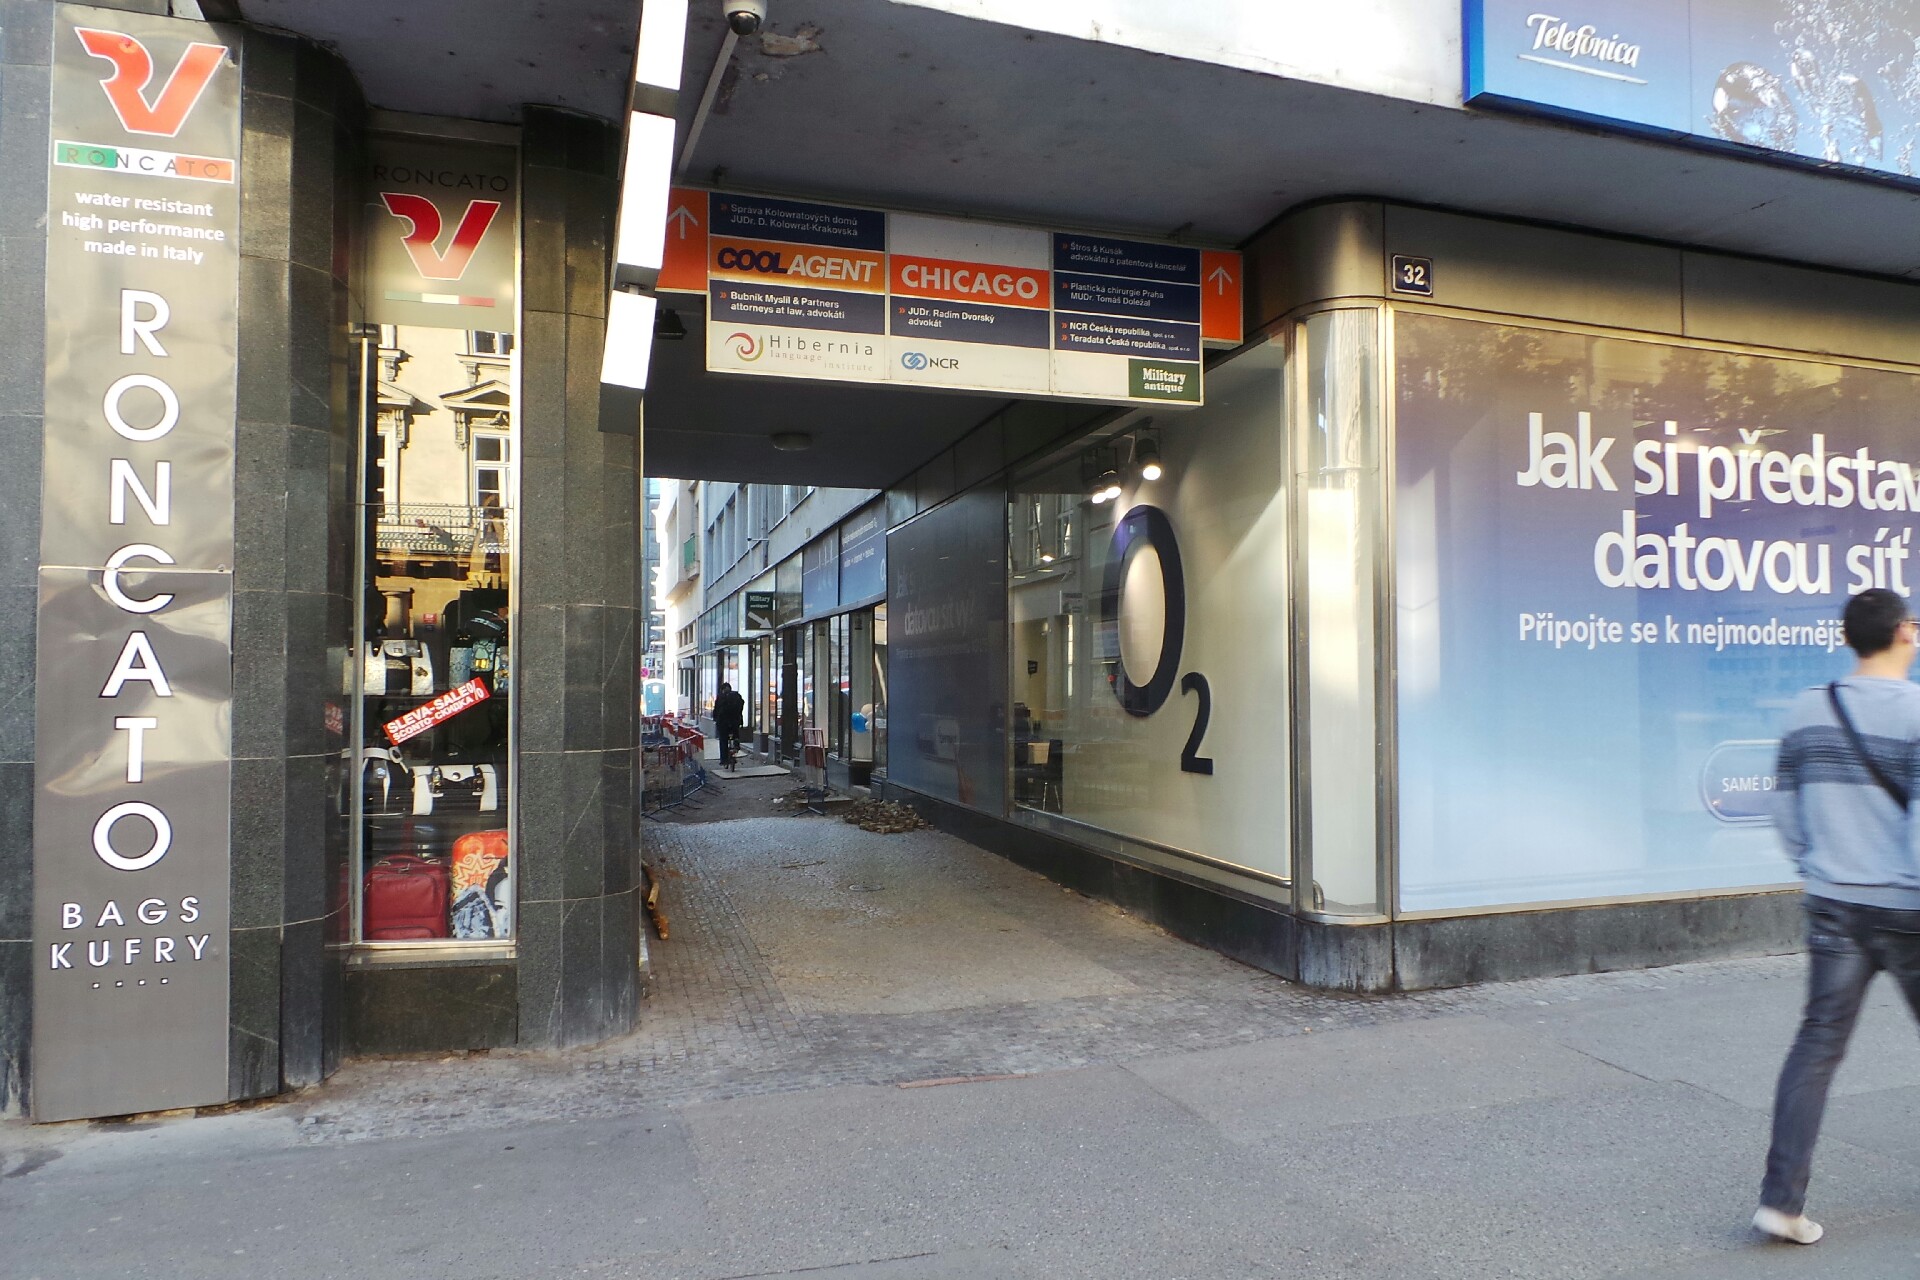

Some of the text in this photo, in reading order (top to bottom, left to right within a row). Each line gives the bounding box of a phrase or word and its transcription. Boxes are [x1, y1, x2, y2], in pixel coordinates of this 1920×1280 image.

[66, 147, 220, 178] RONCATO
[373, 165, 509, 192] RONCATO
[75, 191, 213, 217] water resistant
[62, 211, 225, 241] high performance
[730, 215, 756, 225] JUDr.
[758, 217, 768, 226] D.
[84, 238, 204, 265] made in Italy
[901, 264, 1039, 300] CHICAGO
[1403, 264, 1425, 287] 32
[1070, 282, 1164, 299] Plastická chirurgie Praha
[730, 302, 845, 319] attorneys at law, advokáti
[792, 297, 800, 305] &
[801, 297, 840, 309] Partners
[907, 307, 995, 324] JUDr. Radim Dvorský
[908, 317, 943, 328] advokát
[1069, 322, 1088, 331] NCR
[1089, 322, 1113, 334] Česká
[770, 335, 873, 356] Hibernia
[1069, 333, 1104, 345] Teradata
[1105, 335, 1130, 347] Česká
[770, 350, 823, 362] language
[824, 360, 873, 372] institute
[929, 357, 959, 370] NCR
[1142, 367, 1186, 385] Military
[1143, 381, 1183, 394] antique
[1516, 411, 1619, 492] Jak
[1633, 420, 1679, 496] si
[1593, 510, 1912, 598] datovou síť
[92, 288, 180, 871] RONCATO
[1519, 612, 1624, 650] Připojte
[1630, 621, 1659, 644] se
[1665, 614, 1681, 644] k
[1722, 774, 1760, 793] SAMÉ
[62, 896, 200, 930] BAGS
[50, 934, 211, 970] KUFRY
